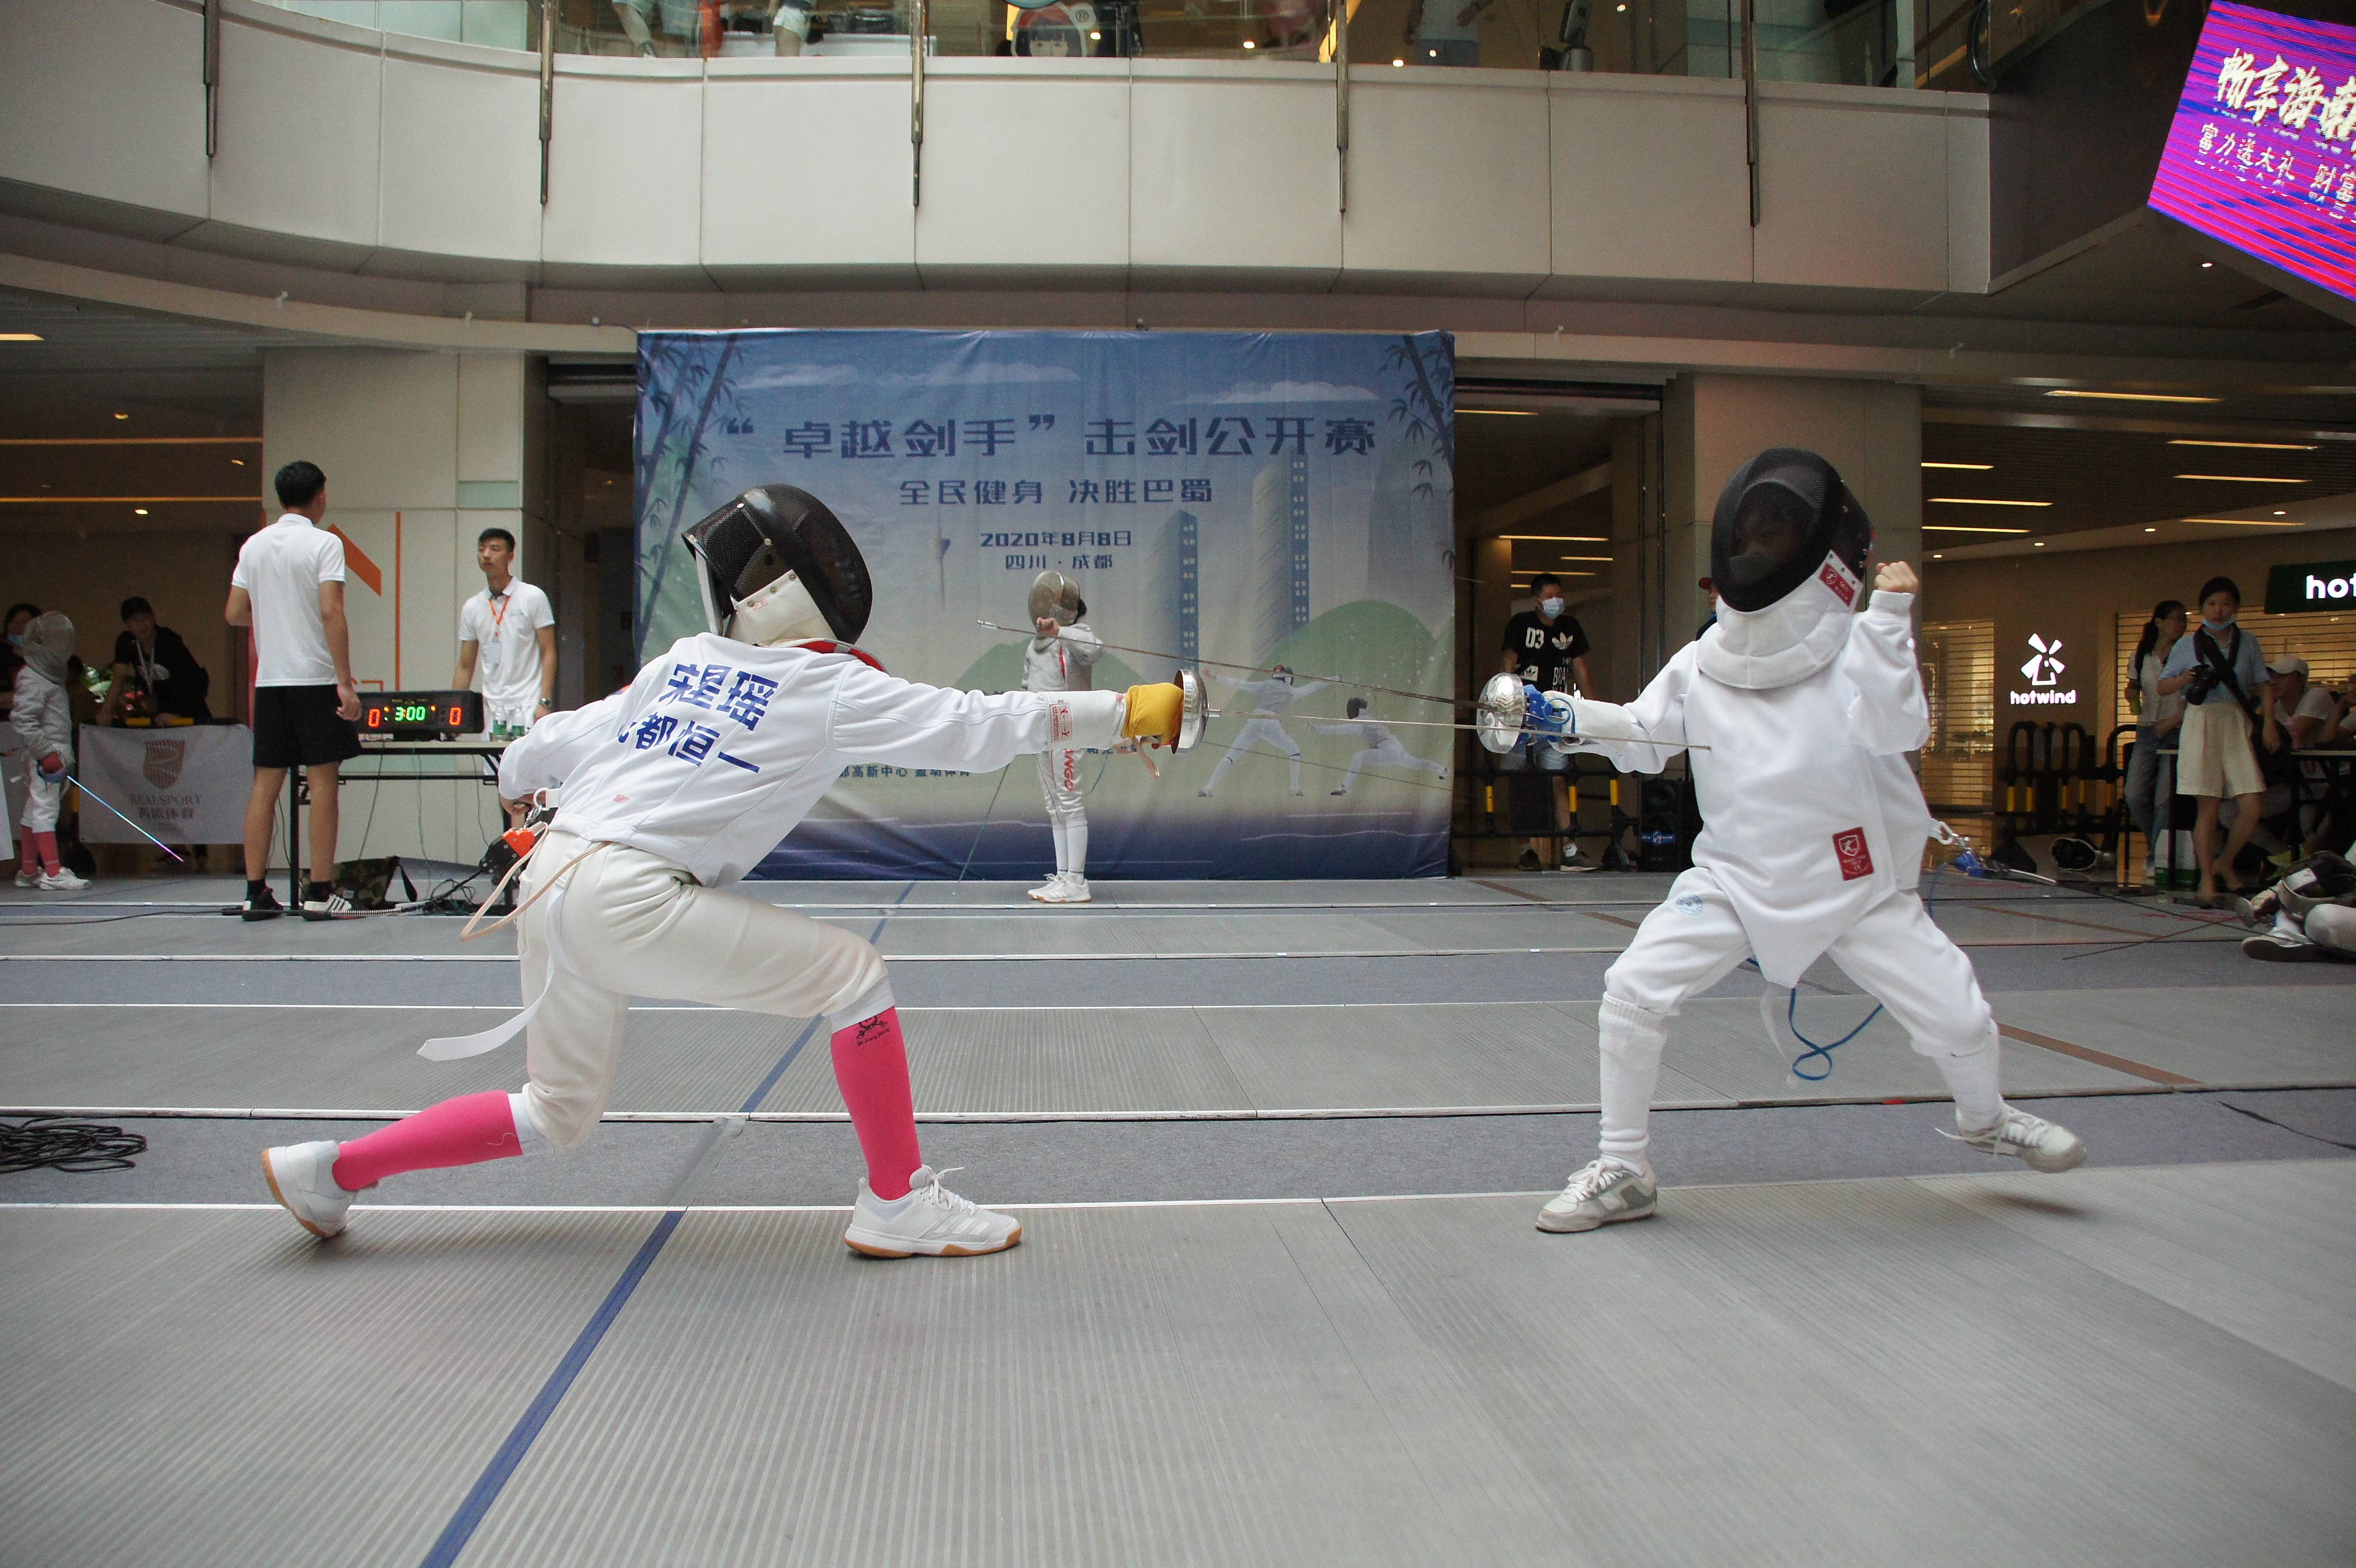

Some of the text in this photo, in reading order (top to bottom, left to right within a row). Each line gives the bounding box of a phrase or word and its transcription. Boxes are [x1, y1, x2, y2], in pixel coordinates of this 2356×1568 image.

[900, 478, 1212, 505] 全民健身 决胜巴蜀
[980, 531, 1131, 546] 2020年8月8日
[1525, 627, 1544, 649] 03
[2010, 689, 2076, 704] hotwind
[368, 709, 380, 728] 0
[449, 707, 462, 726] 0
[617, 712, 760, 773] 都恒一
